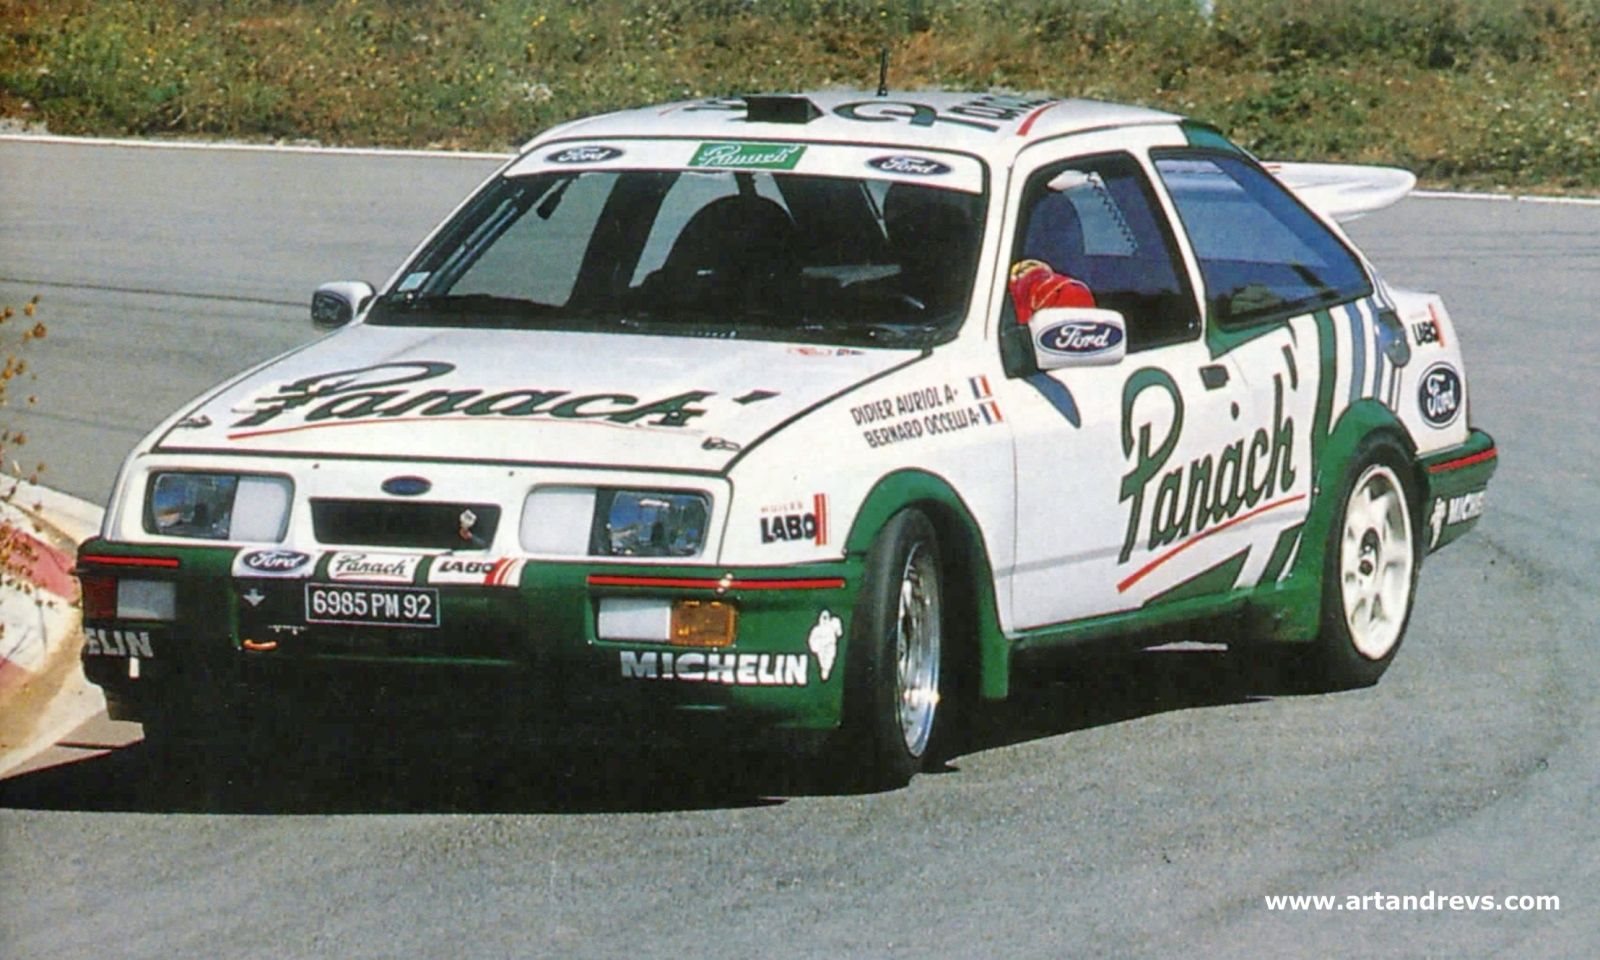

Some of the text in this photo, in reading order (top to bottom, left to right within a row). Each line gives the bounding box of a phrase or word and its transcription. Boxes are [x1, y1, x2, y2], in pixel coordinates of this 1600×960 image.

[1055, 323, 1111, 348] Ford
[850, 398, 895, 425] DIDIER
[896, 387, 944, 414] AURIOL
[1427, 374, 1456, 417] Ford
[863, 418, 923, 448] BERNARD
[924, 408, 969, 436] OCCELLI
[760, 512, 817, 544] LABO
[438, 561, 495, 574] LABO
[312, 590, 432, 620] 6985 PM 92
[620, 650, 808, 685] MICHELIN
